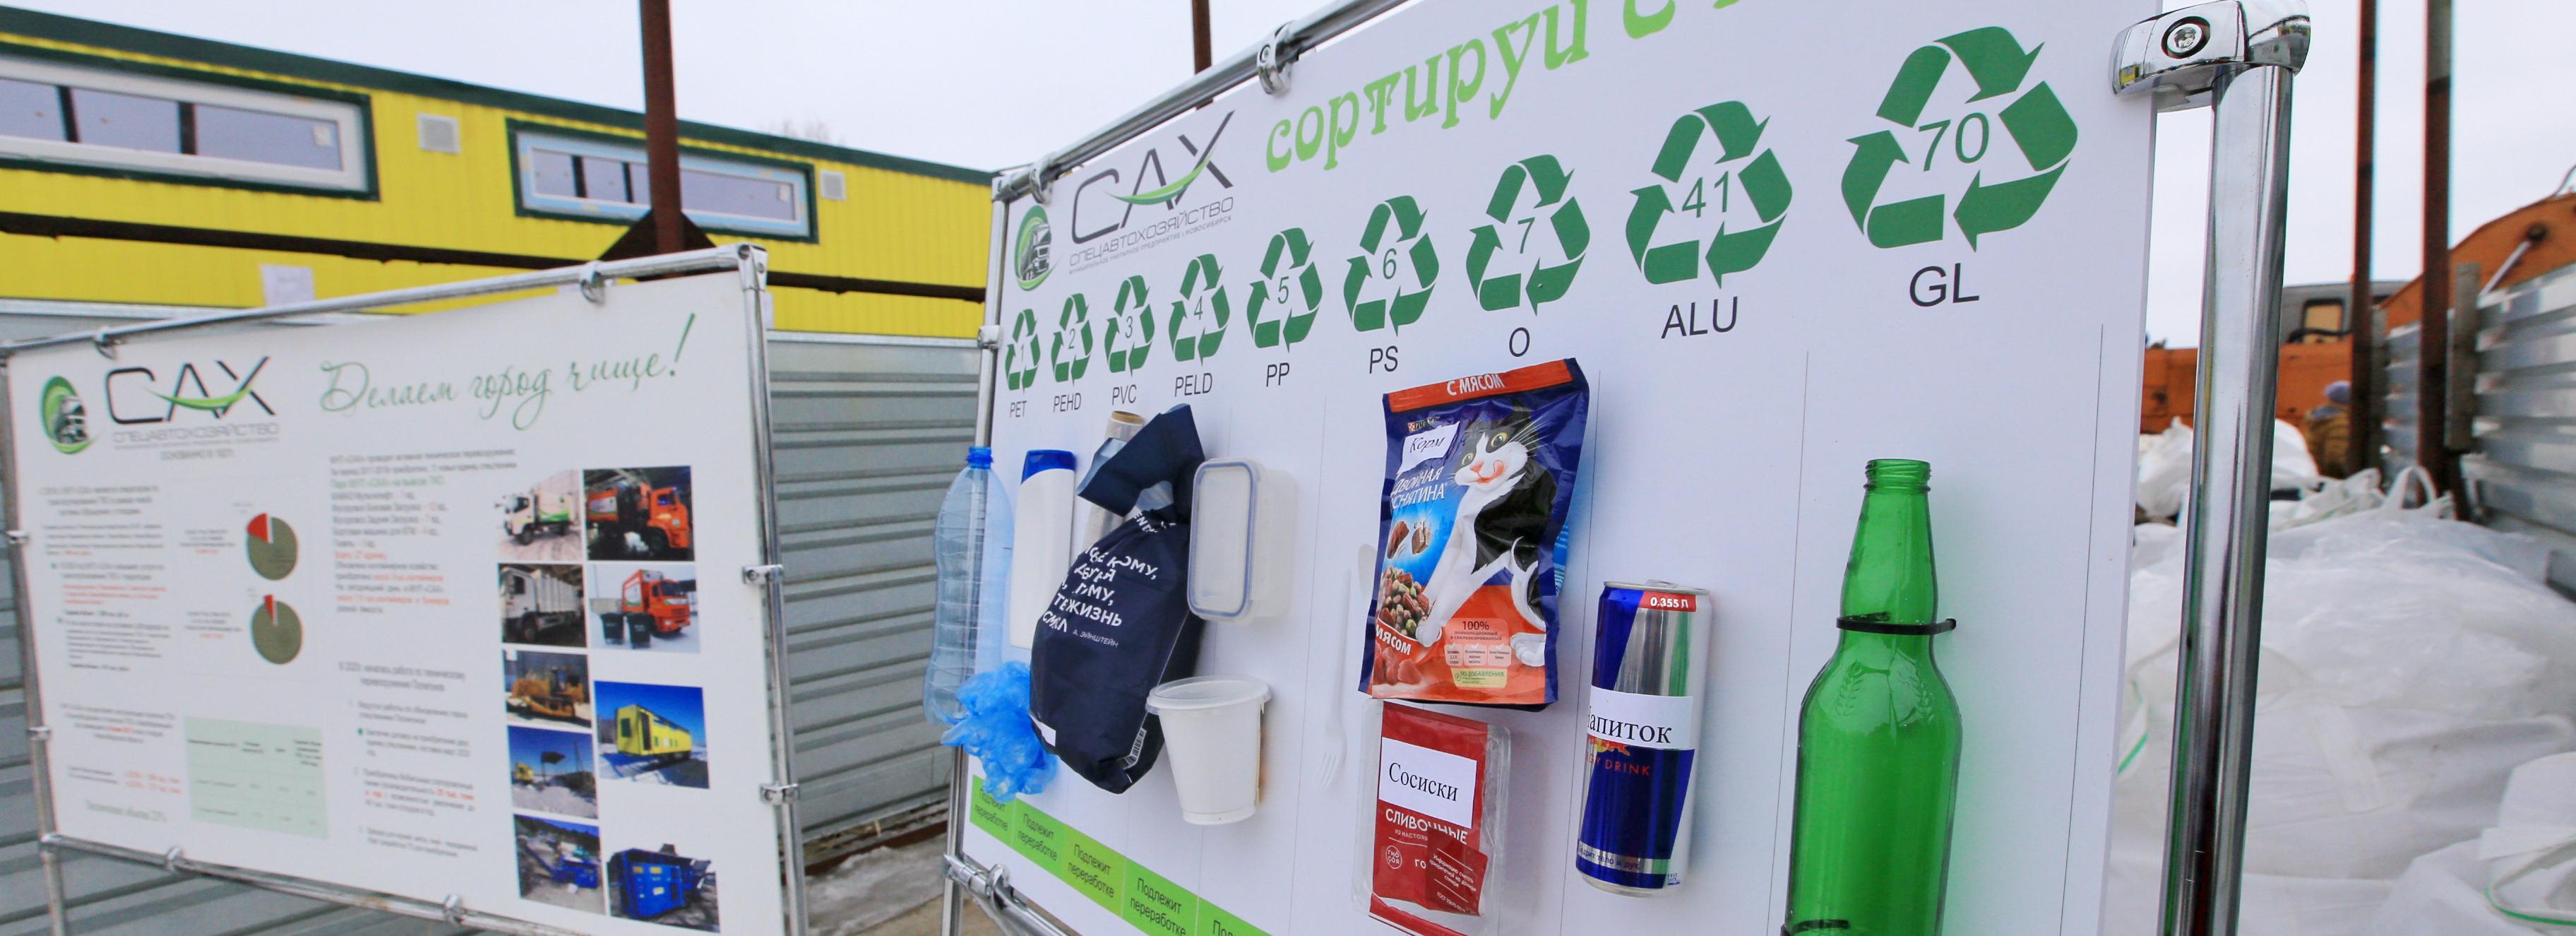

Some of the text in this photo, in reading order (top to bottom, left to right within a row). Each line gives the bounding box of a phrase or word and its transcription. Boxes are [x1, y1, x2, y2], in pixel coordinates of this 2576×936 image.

[1918, 112, 1990, 172] 70
[1071, 109, 1235, 244] САХ
[1681, 170, 1730, 219] 41
[1069, 196, 1234, 266] СПЕЦАВТОХОЗЯЙСТВО
[1140, 233, 1181, 252] ПРЕДПРИЯТИЕ
[1185, 215, 1232, 237] НОВОСИБИРСК
[1517, 217, 1536, 255] 7
[1382, 247, 1397, 280] 6
[1277, 276, 1289, 304] 5
[1909, 263, 1980, 307] GL
[1193, 295, 1203, 321] 4
[1661, 296, 1739, 340] ALU
[1068, 328, 1076, 350] 2
[1125, 315, 1133, 339] 3
[1020, 342, 1025, 362] 1
[1368, 345, 1399, 374] PS
[319, 313, 696, 432] Делаем город чище!
[1174, 372, 1213, 398] PELD
[1266, 362, 1290, 388] PP
[1447, 373, 1505, 396] С МЯСОМ
[106, 355, 276, 425] САХ
[1053, 393, 1082, 413] PEHD
[1111, 384, 1137, 405] PVC
[1009, 401, 1027, 418] PET
[1409, 437, 1445, 454] Корм
[1080, 631, 1119, 648] ЭЙНШТЕЙН
[1462, 621, 1490, 631] 100%
[1588, 706, 1672, 744] апиток
[1388, 762, 1458, 802] Сосиски
[1605, 759, 1651, 776] DRINK
[1023, 813, 1055, 841] Подлежит
[1018, 830, 1058, 862] переработке
[1073, 843, 1111, 875] Подлежит
[1068, 862, 1115, 899] переработке
[1137, 877, 1182, 915] Подлежит
[1131, 897, 1186, 936] переработке
